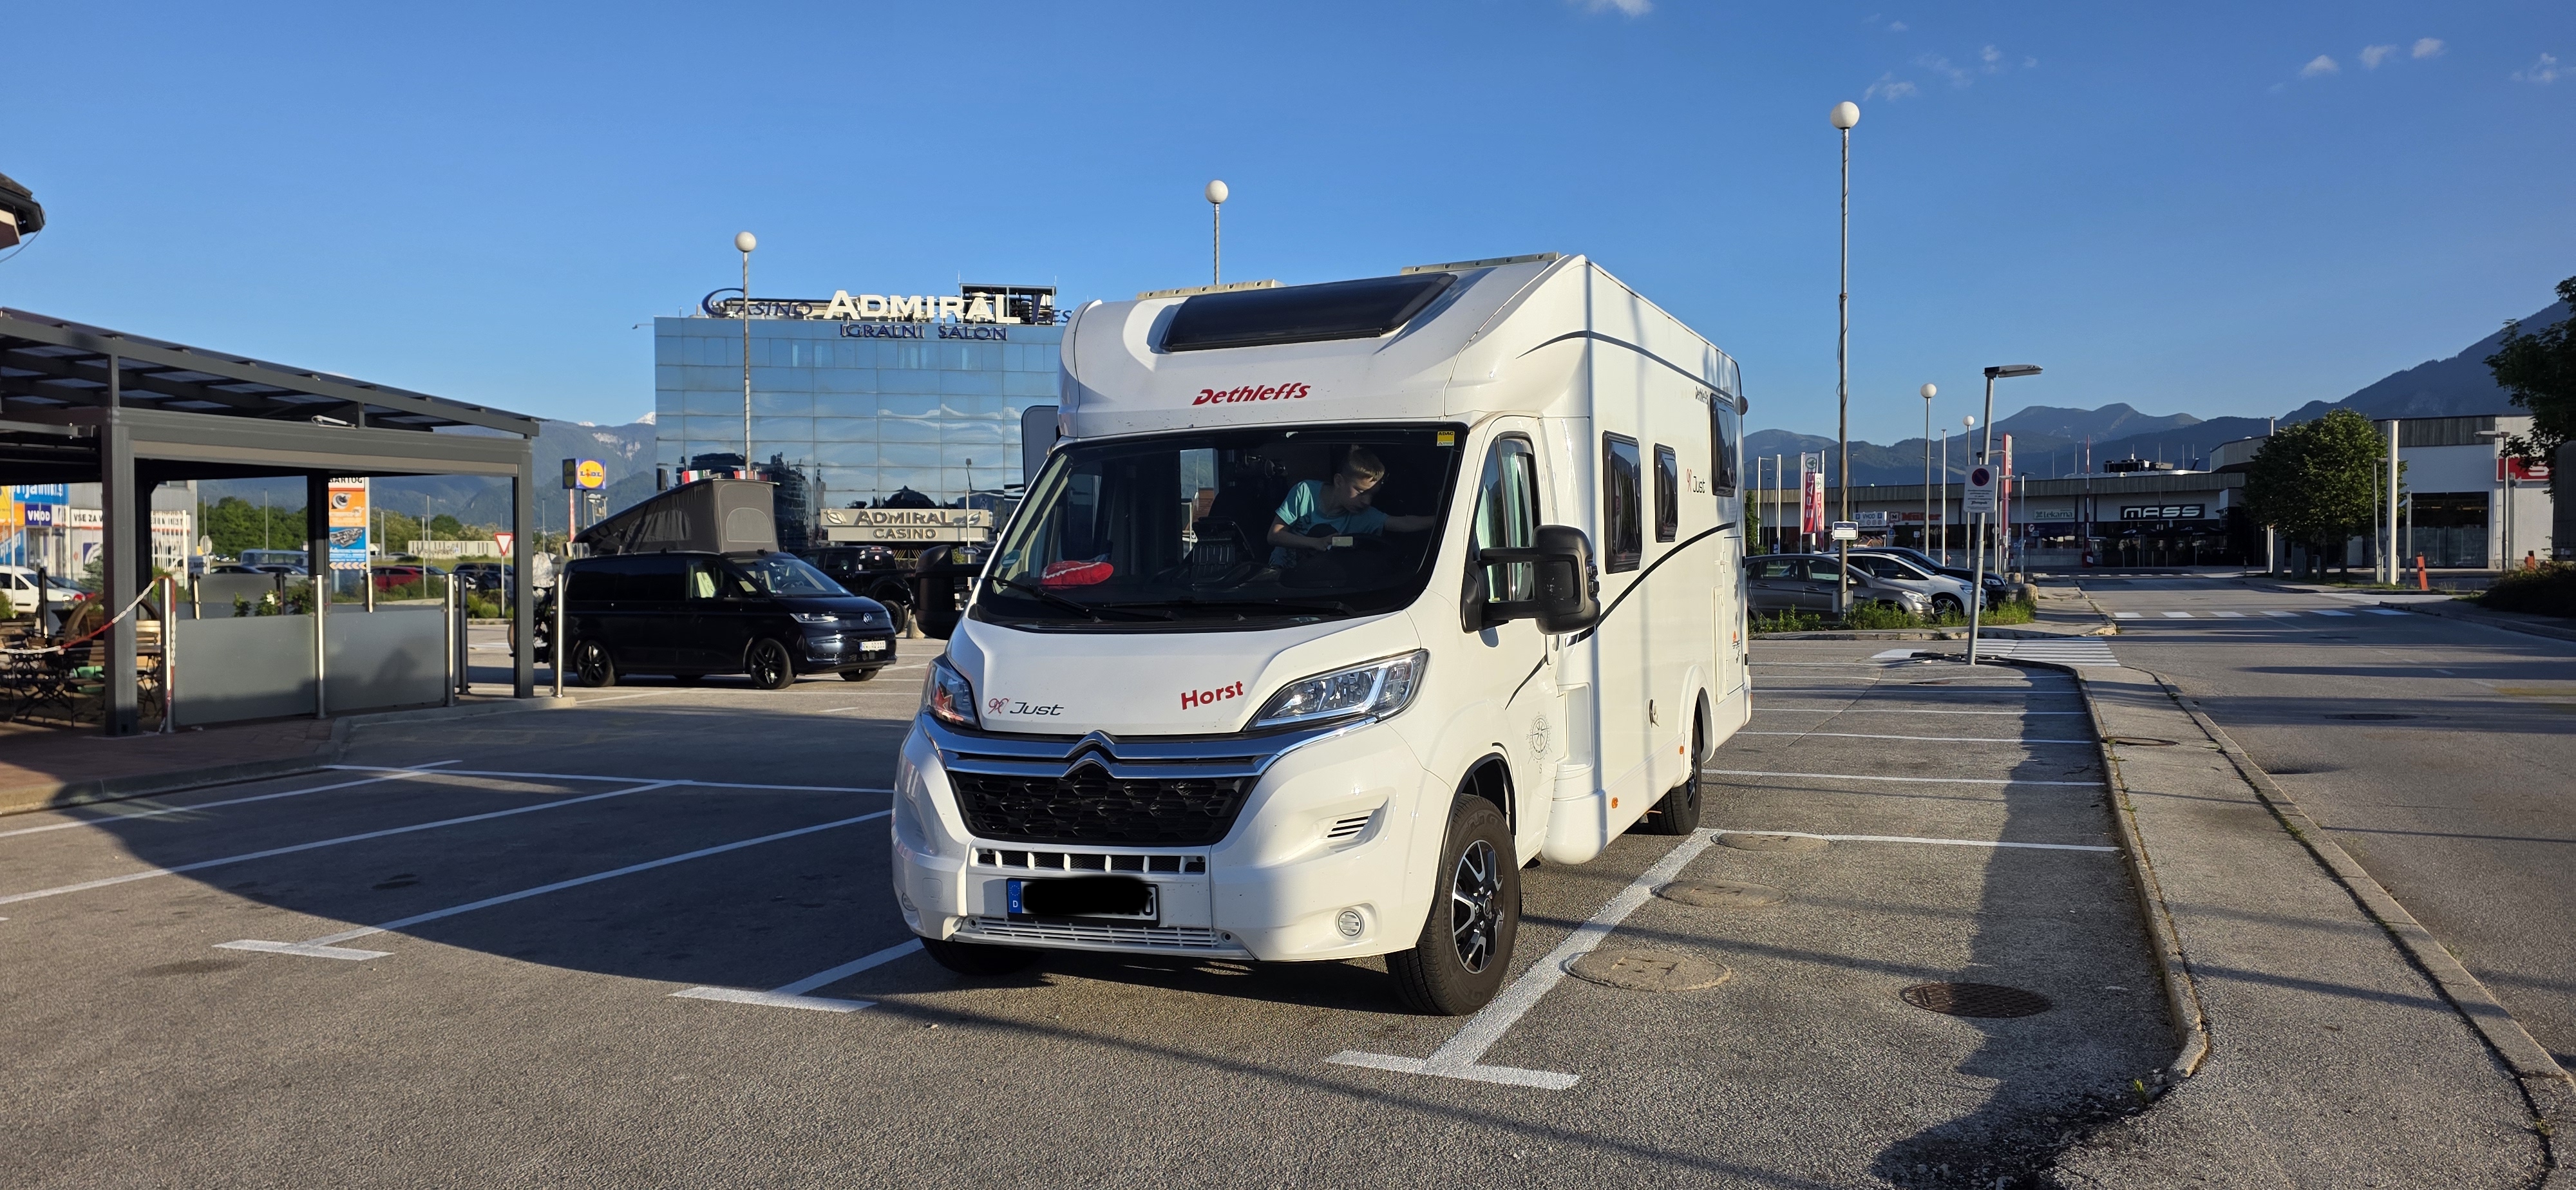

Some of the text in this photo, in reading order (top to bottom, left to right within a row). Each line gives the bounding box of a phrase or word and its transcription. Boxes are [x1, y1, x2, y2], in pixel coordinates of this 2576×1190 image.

[823, 290, 1021, 323] ADMIRAL
[839, 324, 1007, 341] IGRALNI SALON
[1191, 382, 1311, 405] Dethleffs
[1693, 476, 1705, 493] Just
[1806, 473, 1815, 518] SPAR
[27, 510, 51, 521] VHOD
[854, 510, 954, 525] ADMIRAL
[873, 528, 936, 539] CASINO
[1181, 681, 1244, 710] Horst
[1010, 702, 1065, 716] Just
